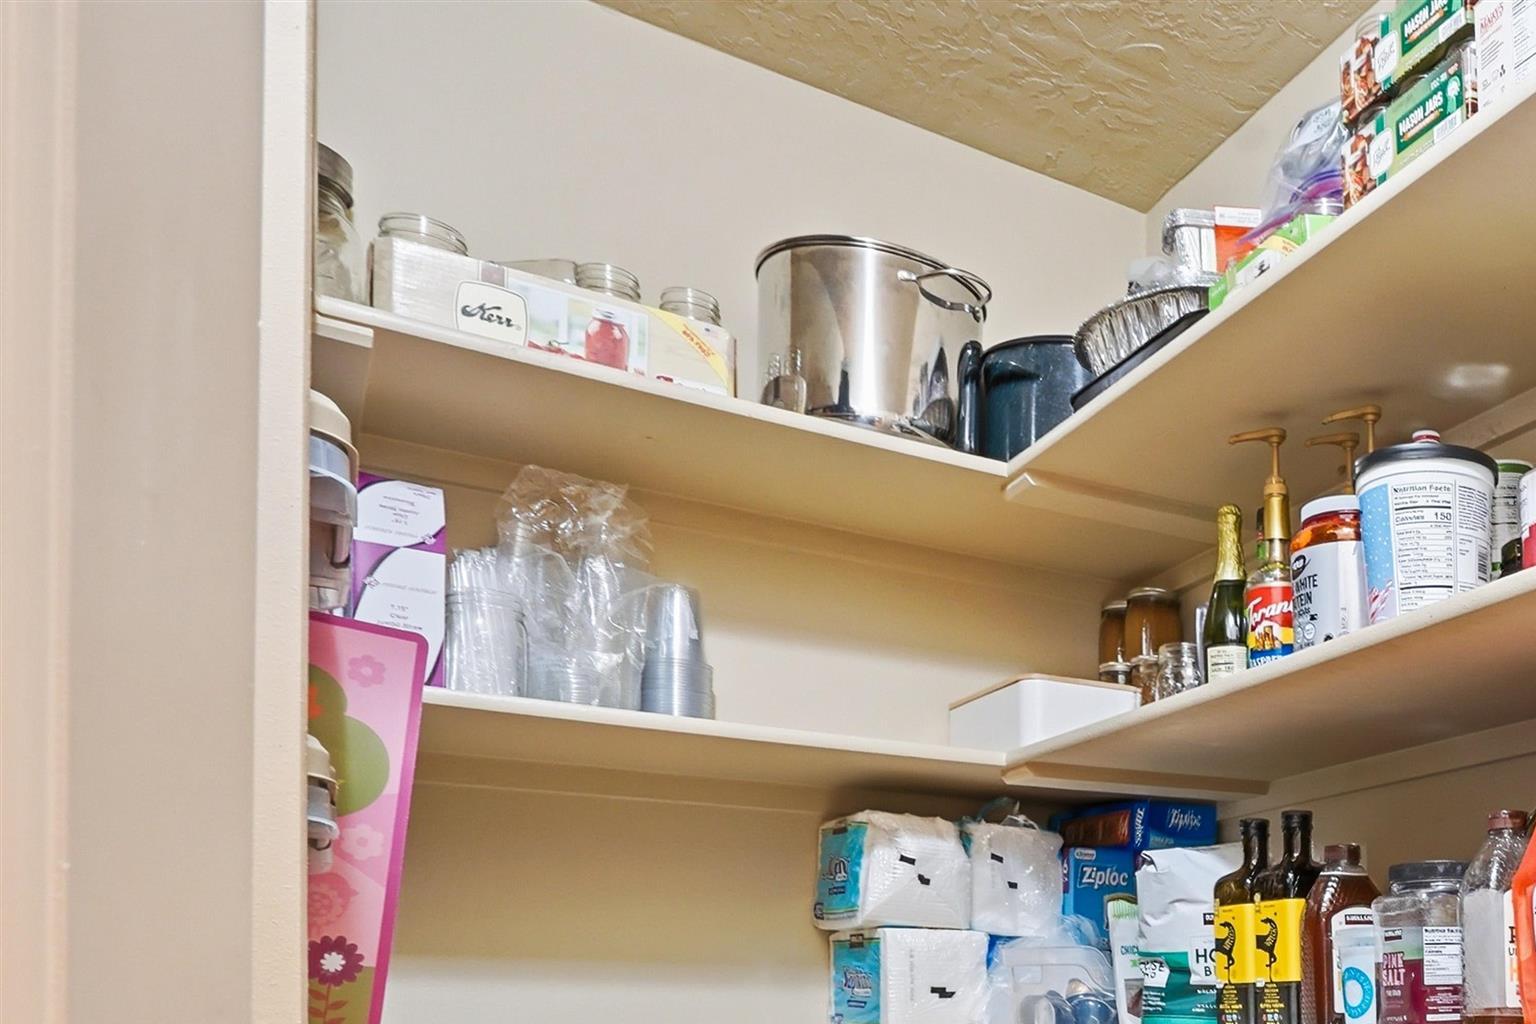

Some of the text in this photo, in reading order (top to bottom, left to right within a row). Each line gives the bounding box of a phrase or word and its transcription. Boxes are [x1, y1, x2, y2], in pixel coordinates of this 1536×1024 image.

[1404, 6, 1431, 37] MASON
[1399, 90, 1444, 137] MASON JARS
[461, 302, 515, 328] Kerr
[1433, 511, 1452, 522] 150
[1081, 866, 1129, 889] Ziploc
[1382, 951, 1405, 969] PINK
[1382, 968, 1406, 986] SALT
